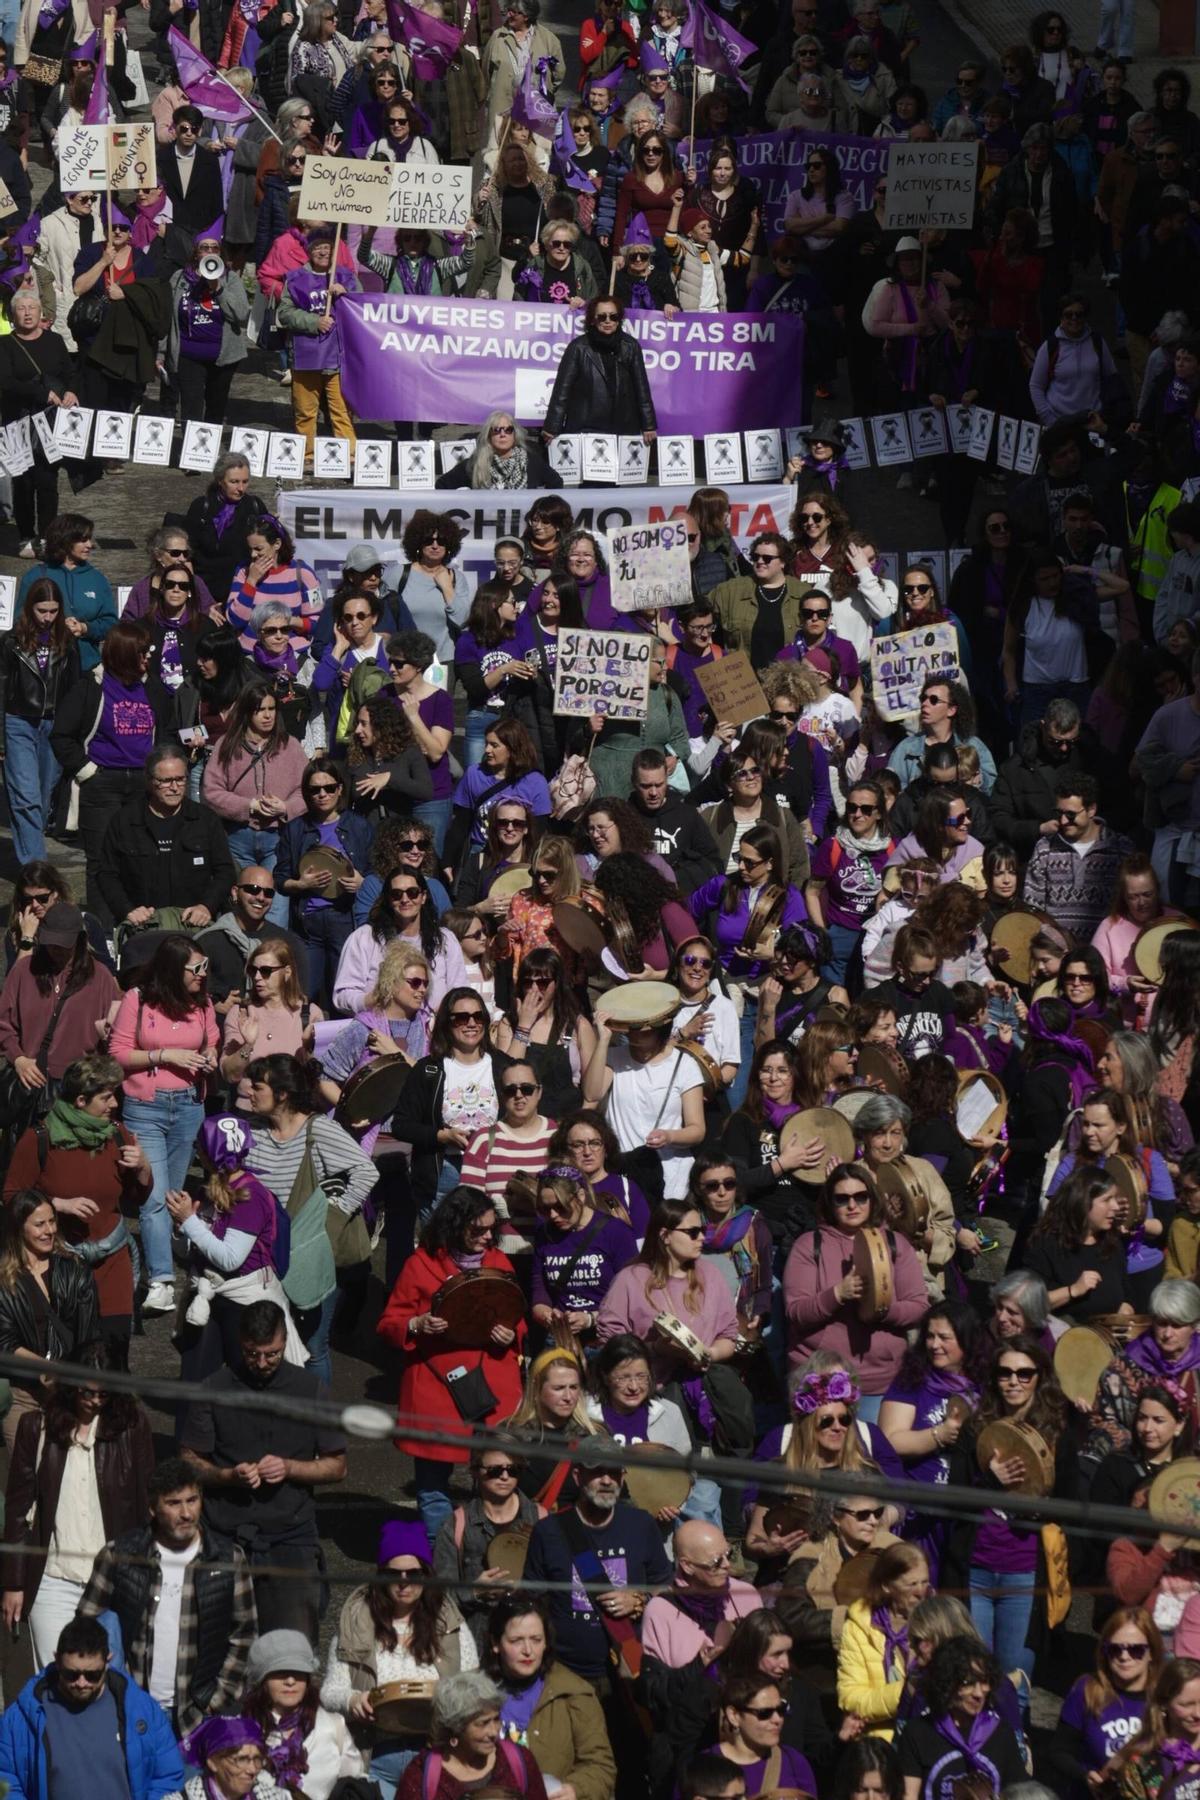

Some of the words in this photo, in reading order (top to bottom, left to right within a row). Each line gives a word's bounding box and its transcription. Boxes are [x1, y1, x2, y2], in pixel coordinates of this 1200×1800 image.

[61, 145, 78, 163] NO
[72, 127, 89, 146] ME
[63, 136, 99, 187] IGNORES
[896, 152, 974, 167] MAYORES
[311, 163, 336, 186] Soy
[397, 170, 464, 188] OMOS
[893, 179, 972, 193] ACTIVISTAS
[307, 201, 328, 212] un
[453, 193, 465, 210] Y
[925, 194, 935, 210] Y
[386, 207, 468, 225] UERRERAS
[888, 212, 968, 227] FEMINISTAS
[363, 302, 505, 330] MUYERES
[515, 311, 725, 343] PENSNISTAS
[731, 322, 775, 343] 8M
[380, 331, 566, 363] AVANZAMOS
[690, 351, 756, 371] TIRA
[294, 506, 347, 540] EL
[648, 503, 781, 538] MTA
[612, 536, 628, 554] NO
[561, 634, 580, 656] SI
[586, 637, 619, 658] NO
[622, 642, 650, 662] LO
[876, 639, 900, 656] NOS
[912, 631, 935, 648] LO
[559, 656, 597, 674] VES
[880, 650, 957, 677] QUITARON
[558, 675, 644, 701] PORQUE
[886, 689, 908, 711] EL
